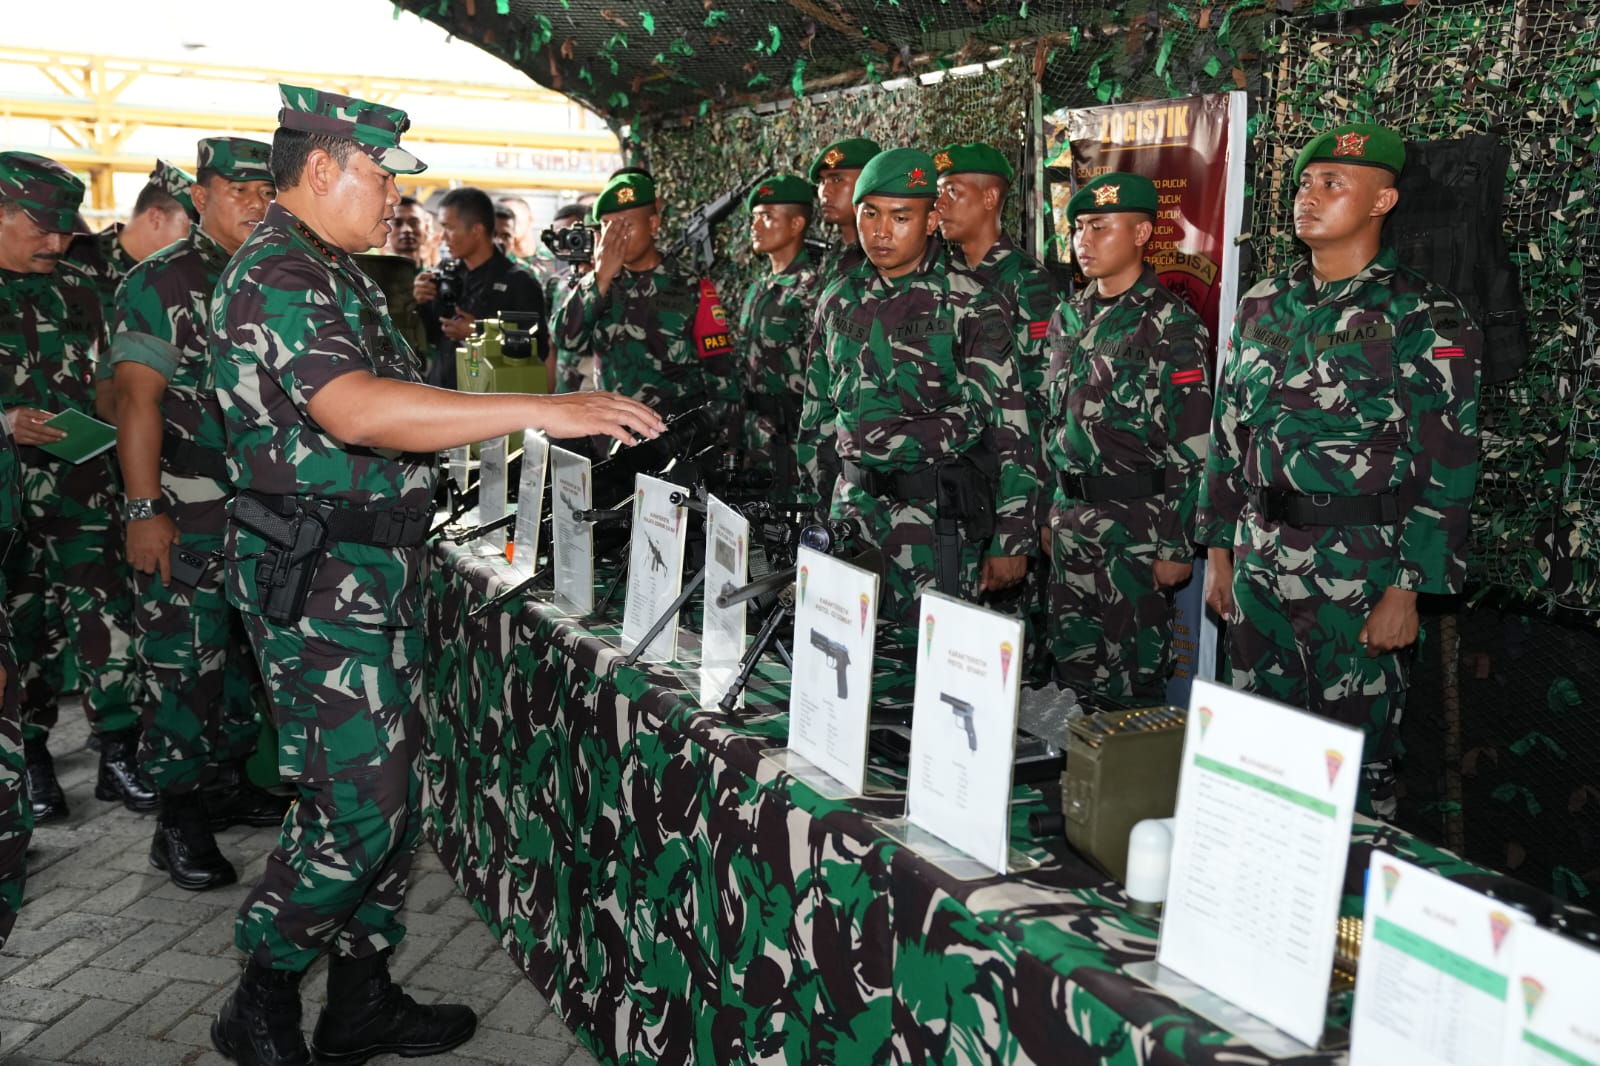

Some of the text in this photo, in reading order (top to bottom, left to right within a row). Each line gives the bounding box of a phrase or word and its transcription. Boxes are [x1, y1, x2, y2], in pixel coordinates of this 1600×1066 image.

[1102, 105, 1188, 145] LOGISTIK
[1162, 178, 1187, 188] PUCUK
[1158, 195, 1182, 204] PUCUK
[1157, 210, 1181, 219] PUCUK
[1154, 225, 1174, 235] UCUK
[1155, 240, 1179, 250] PUCUK
[896, 320, 946, 338] TNI AD
[1328, 326, 1376, 346] TNI AD
